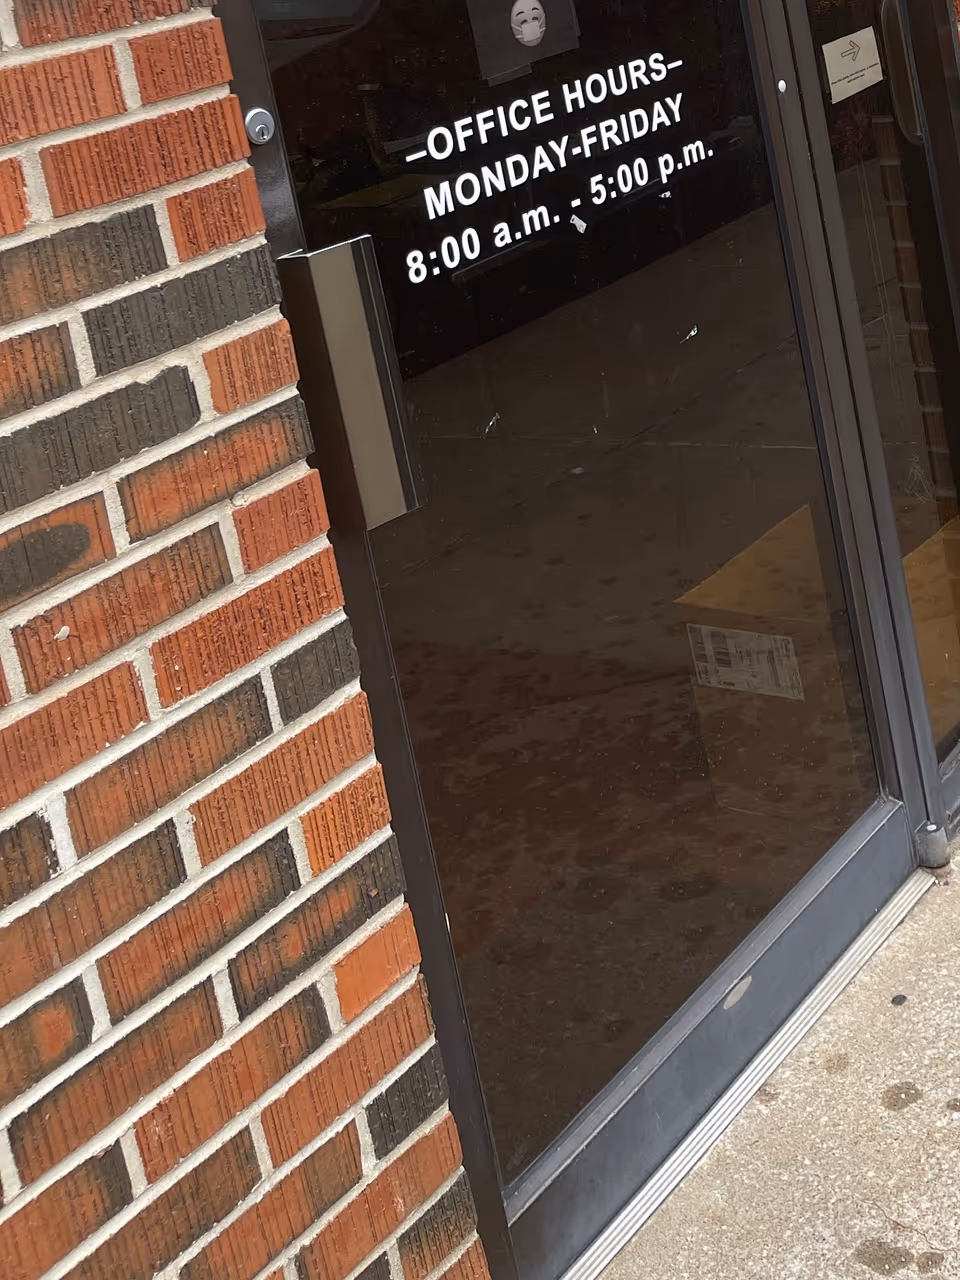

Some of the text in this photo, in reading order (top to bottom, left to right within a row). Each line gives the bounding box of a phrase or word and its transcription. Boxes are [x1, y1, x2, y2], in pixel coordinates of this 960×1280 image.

[405, 227, 481, 284] 8:00
[493, 204, 560, 247] a.m.
[590, 157, 649, 204] 5:00
[658, 139, 714, 184] p.m.
[423, 93, 683, 220] MONDAY-FRIDAY
